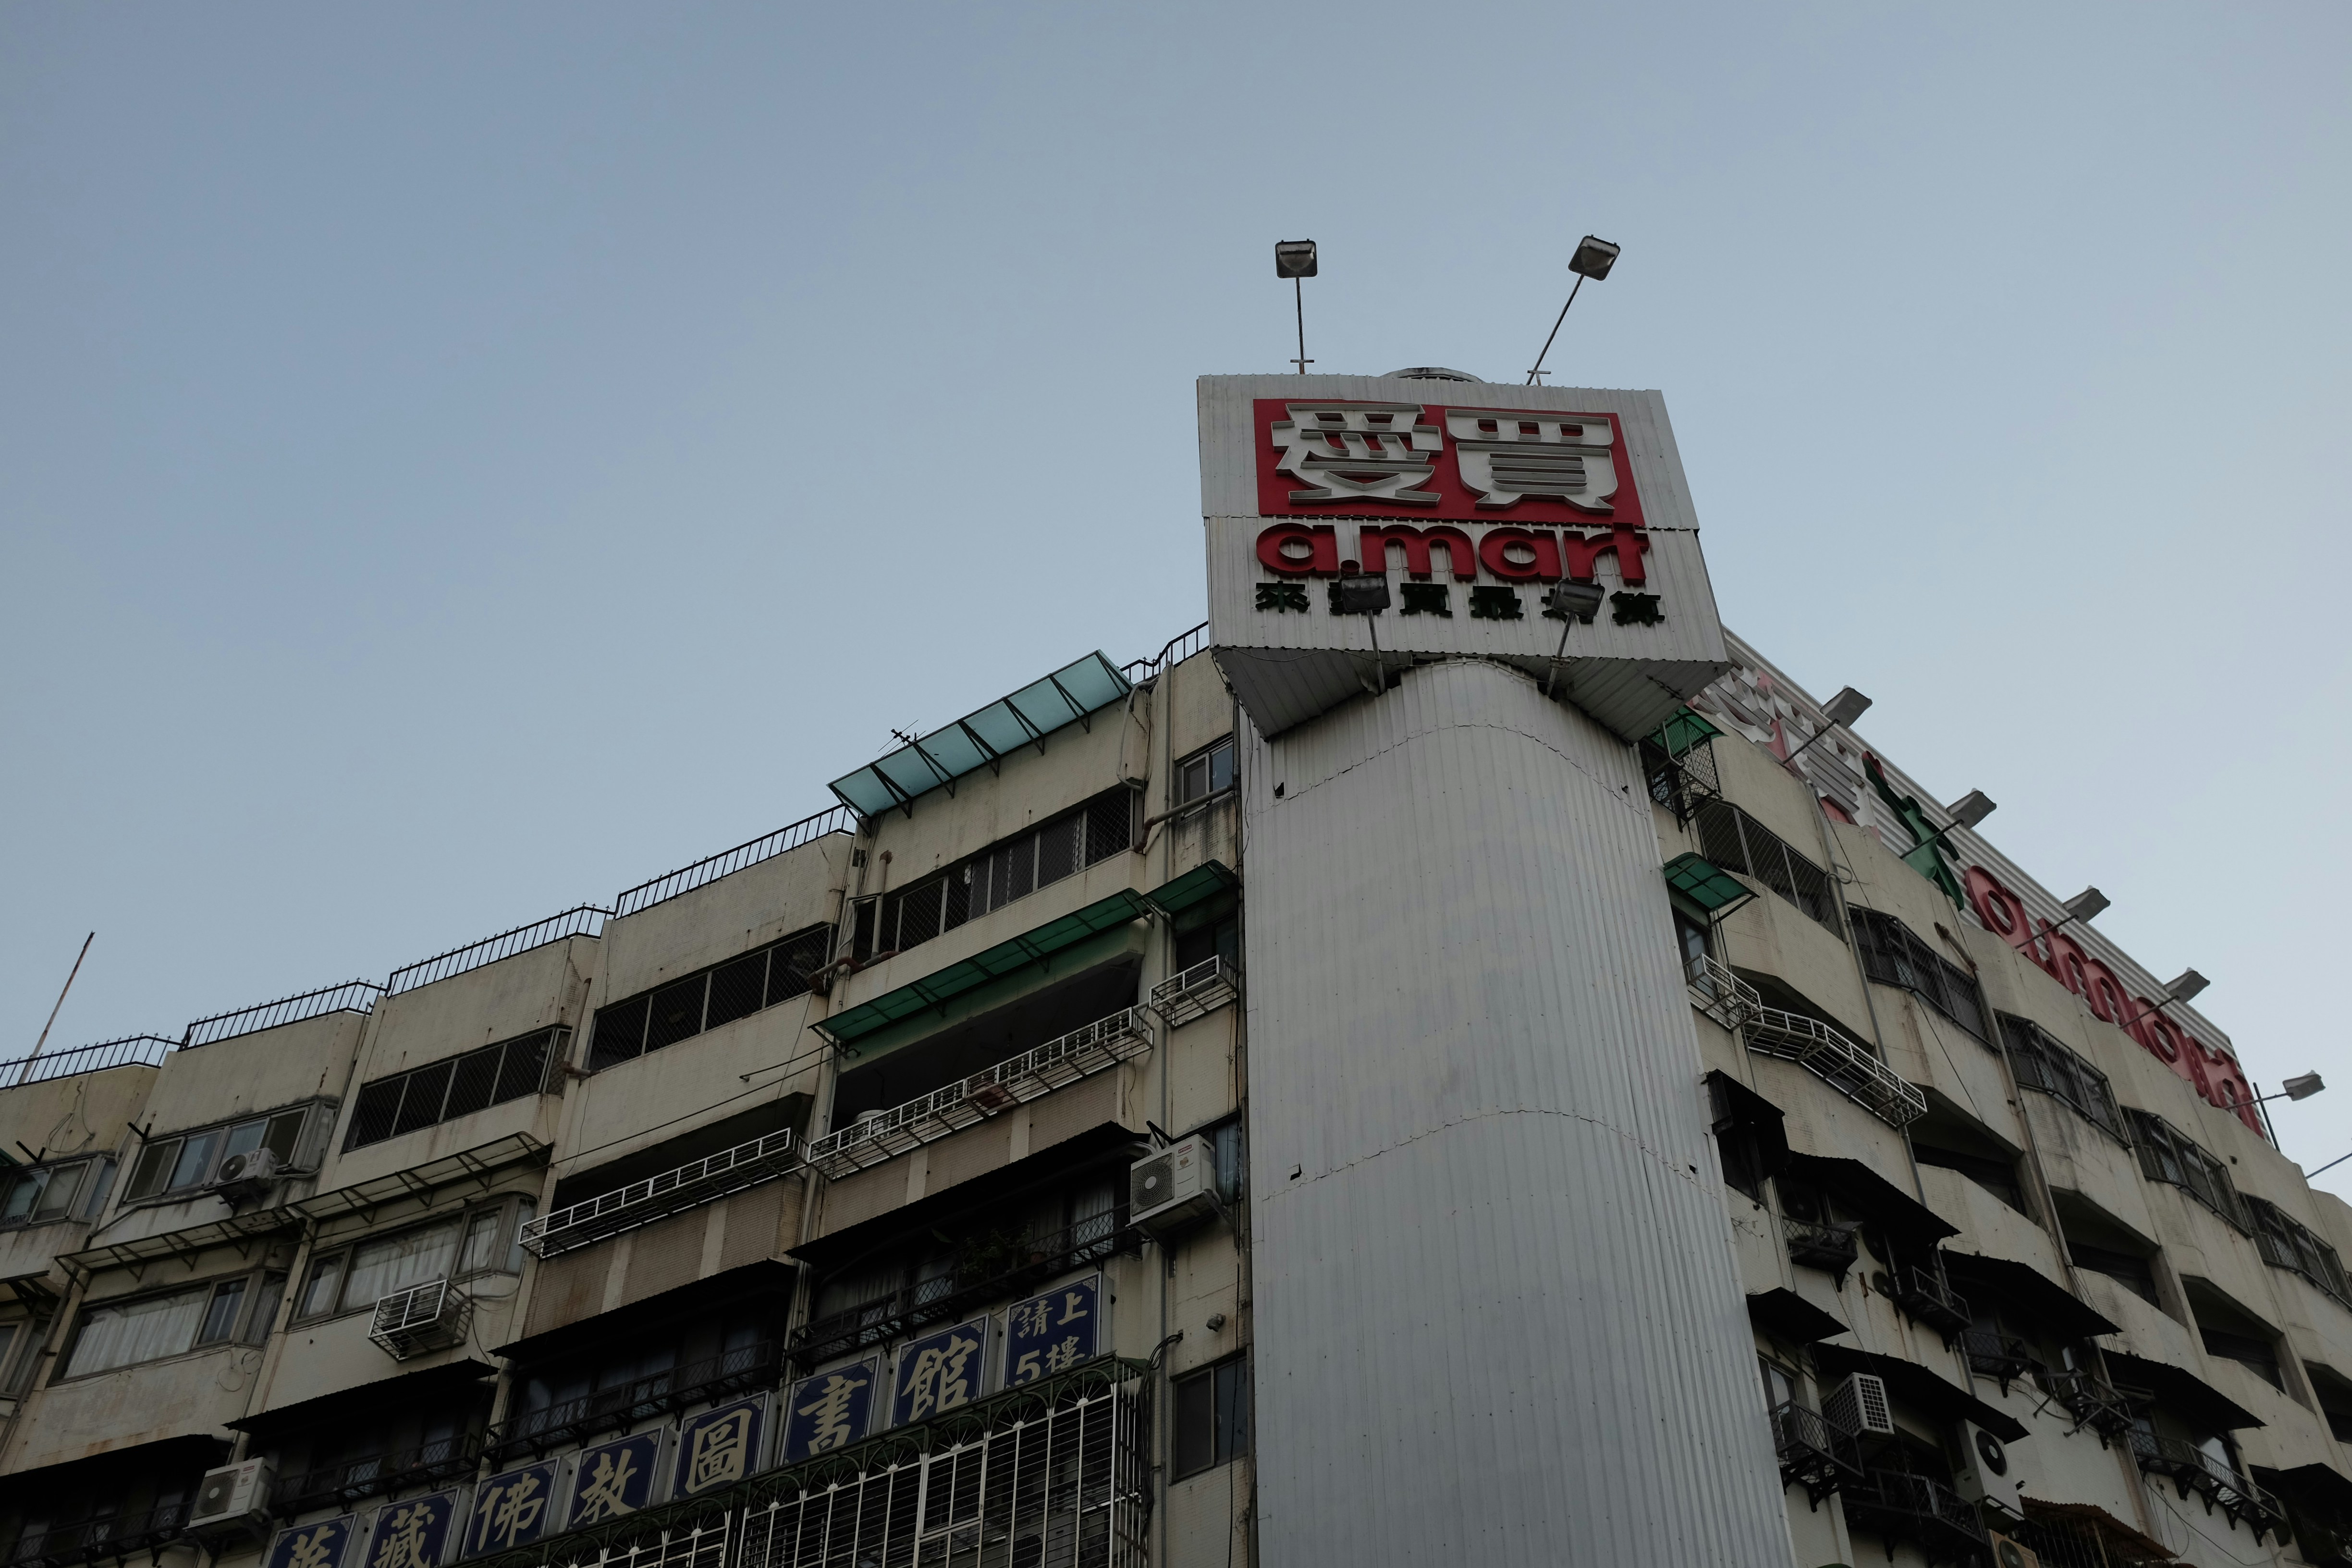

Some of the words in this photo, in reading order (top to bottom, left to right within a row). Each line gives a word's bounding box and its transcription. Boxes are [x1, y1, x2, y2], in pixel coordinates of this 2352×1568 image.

[1272, 403, 1618, 514] 愛買
[1256, 522, 1649, 587] a.mart
[1255, 580, 1666, 626] 來買最算
[1017, 1292, 1088, 1338] 請上
[1014, 1335, 1086, 1386] 5樓
